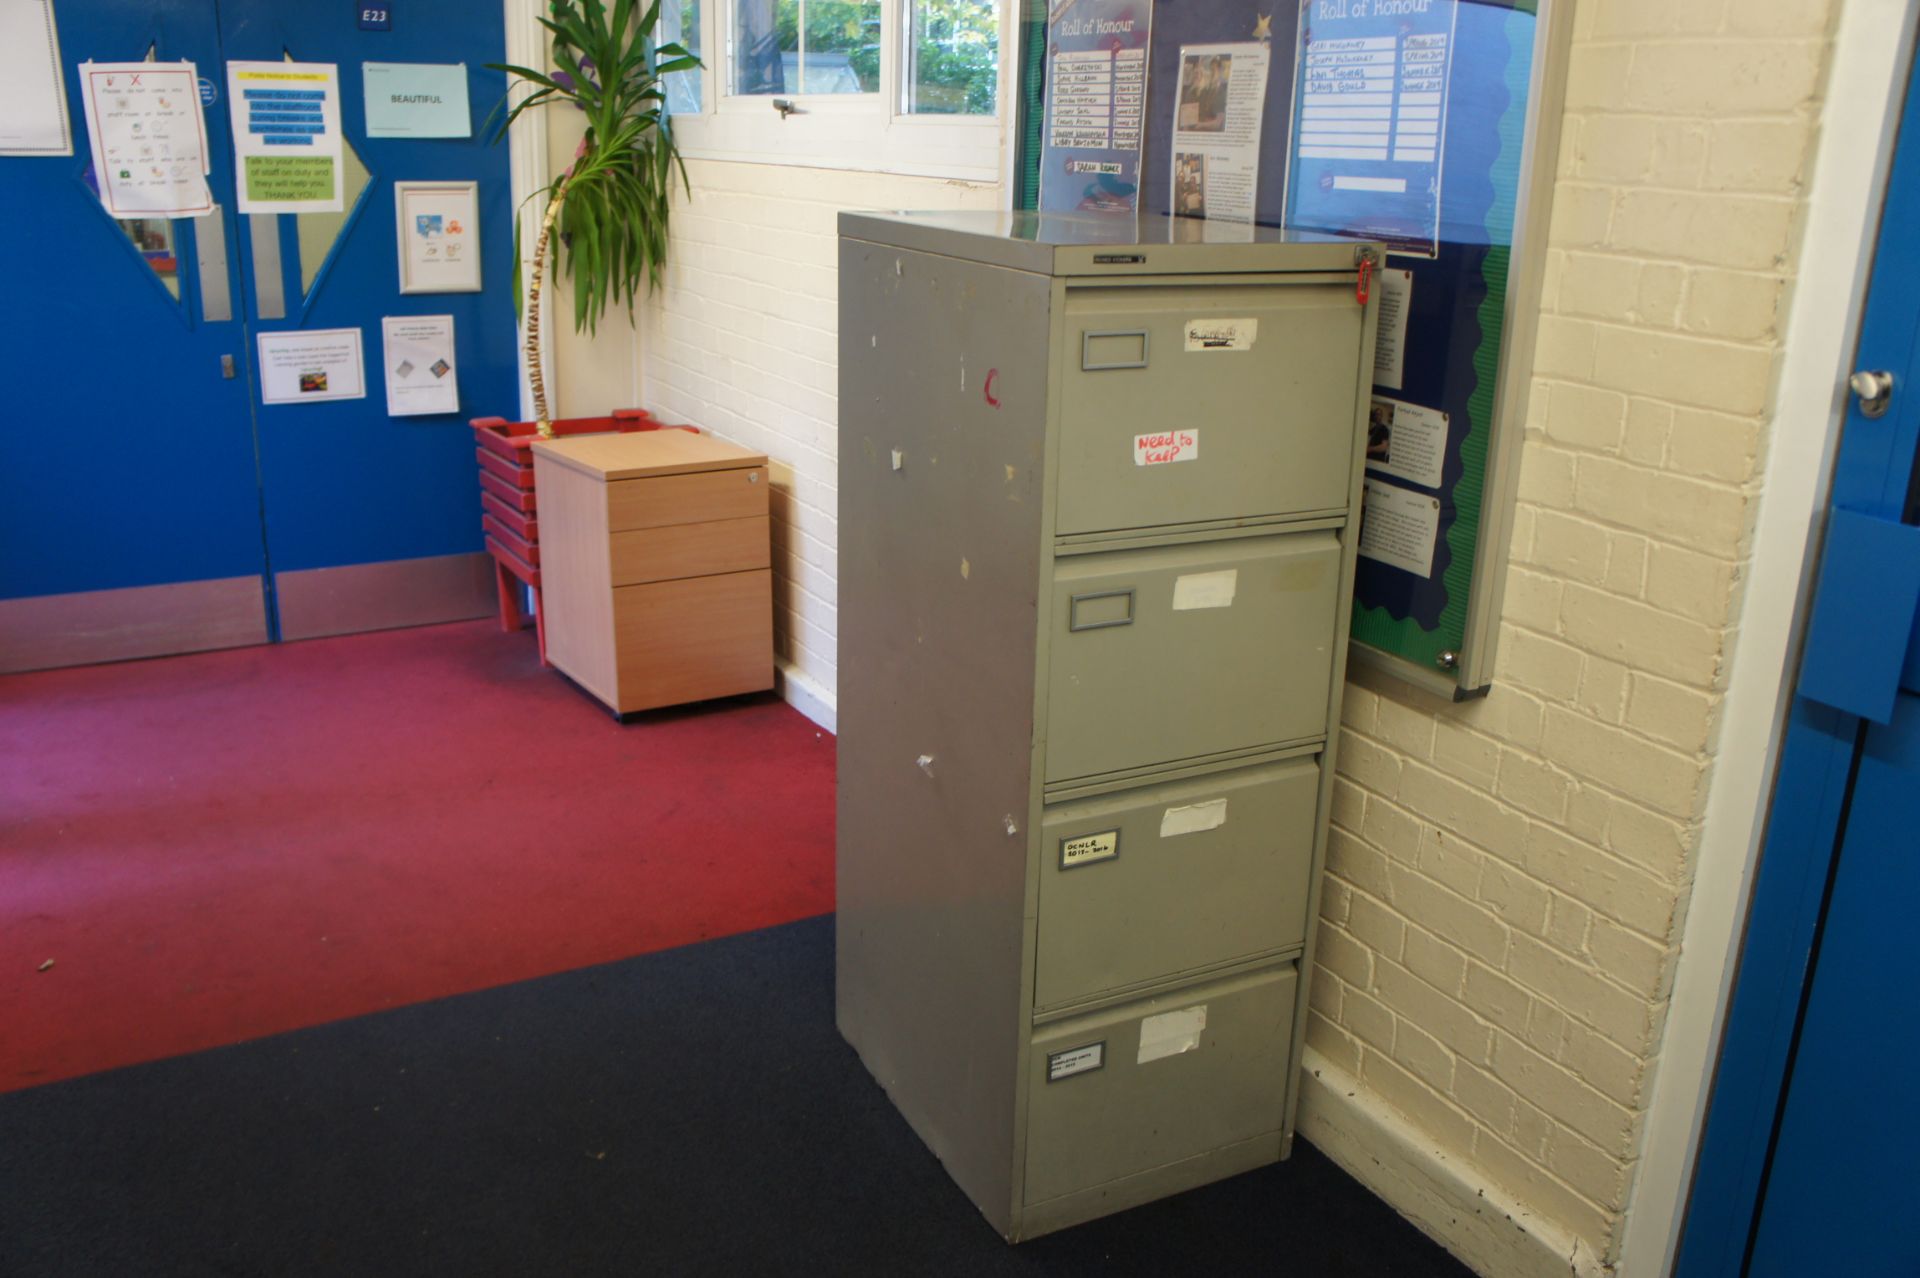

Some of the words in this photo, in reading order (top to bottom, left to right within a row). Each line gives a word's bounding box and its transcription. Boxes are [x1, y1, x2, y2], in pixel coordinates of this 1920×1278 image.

[362, 9, 387, 22] E23
[1320, 0, 1347, 20] Roll
[1351, 0, 1367, 17] of
[1374, 0, 1432, 16] Honour
[1061, 19, 1080, 36] Roll
[1083, 18, 1095, 34] of
[1097, 18, 1134, 34] Honour
[391, 94, 443, 104] BEAUTIFUL
[245, 156, 262, 165] Talk
[275, 158, 293, 168] your
[295, 157, 334, 166] members
[250, 168, 260, 177] of
[261, 168, 280, 177] staff
[281, 169, 292, 177] on
[294, 168, 312, 178] duty
[313, 168, 330, 177] and
[264, 191, 296, 200] THANK
[1180, 433, 1193, 448] to
